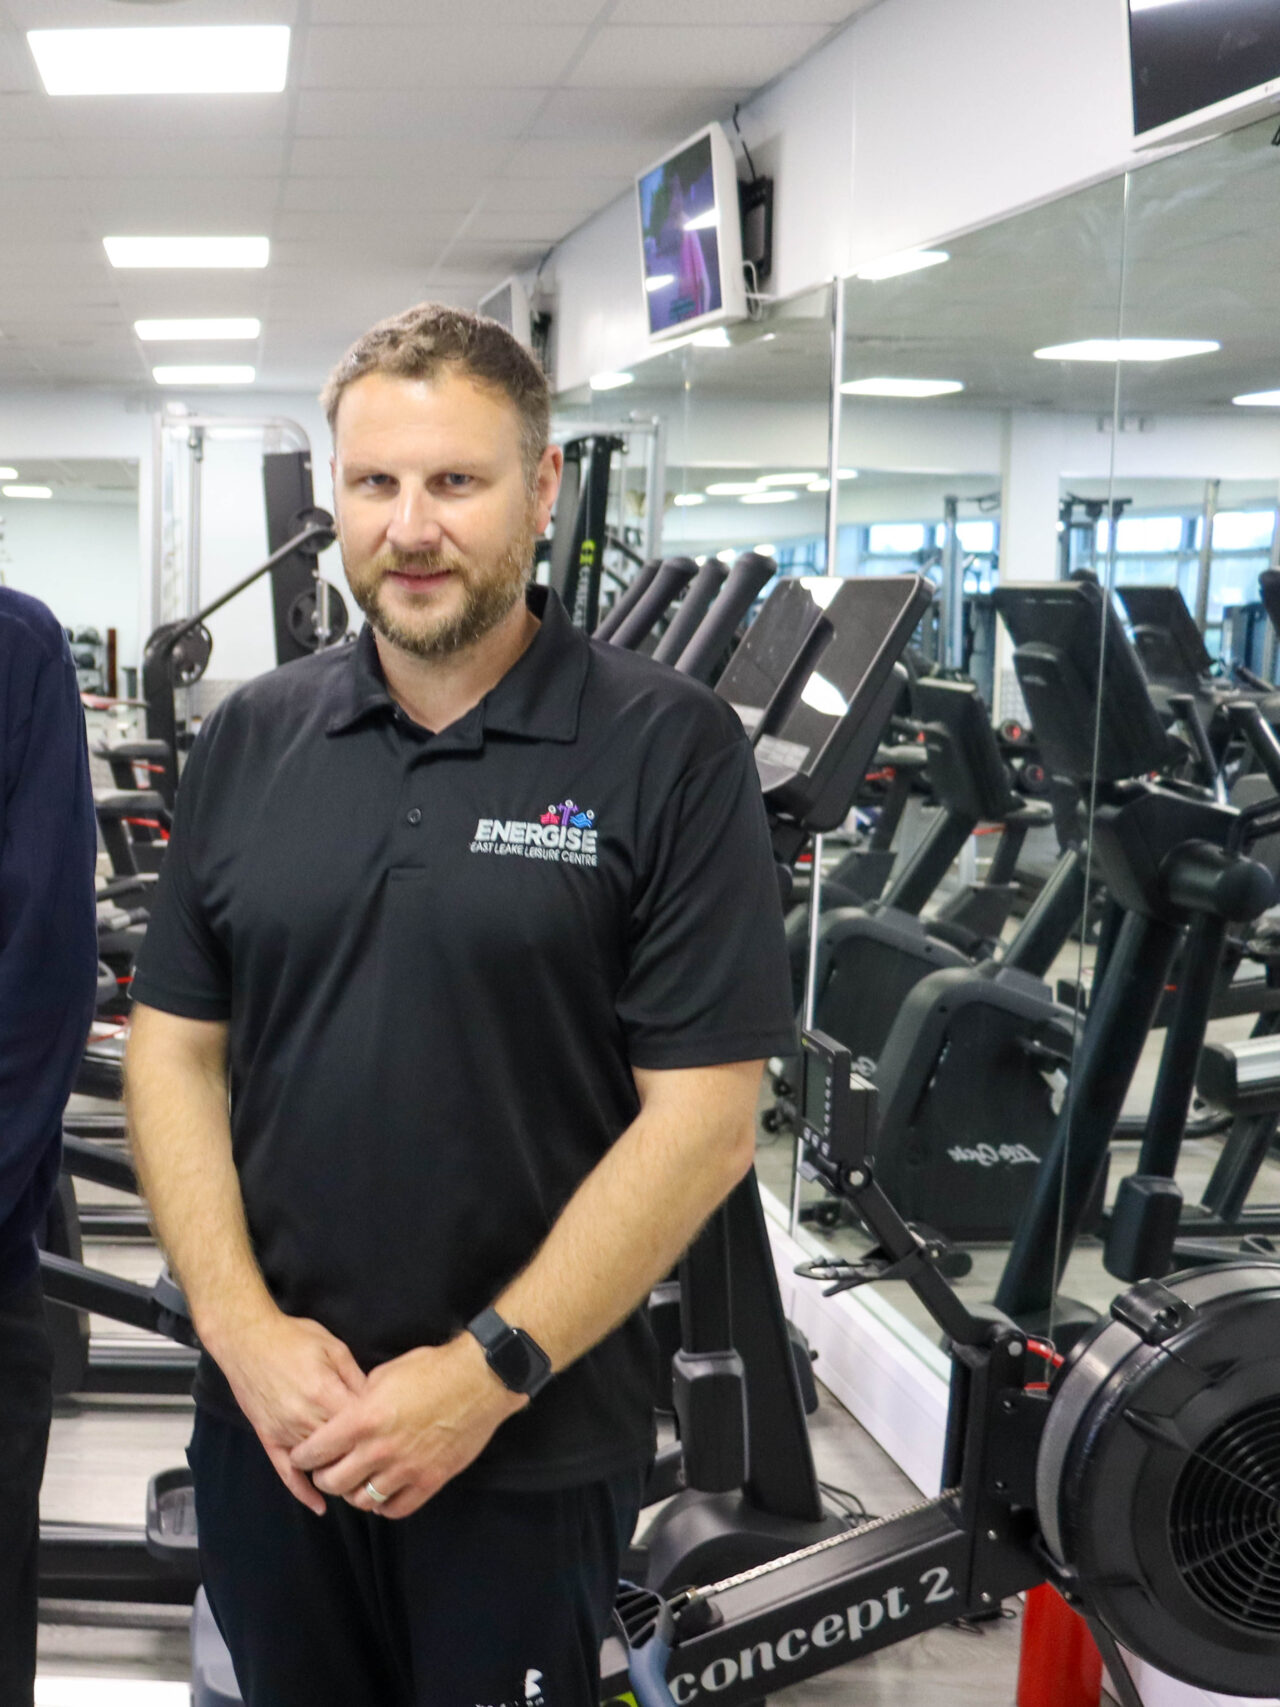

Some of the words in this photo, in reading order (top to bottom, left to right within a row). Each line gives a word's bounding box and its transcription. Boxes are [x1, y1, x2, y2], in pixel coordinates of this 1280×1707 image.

[470, 841, 494, 854] EAST
[494, 842, 524, 857] LEAKE
[524, 845, 561, 862] LEISURE
[561, 850, 598, 867] CENTRE
[474, 818, 598, 854] ENERGISE
[668, 1585, 911, 1706] concept
[919, 1566, 955, 1605] 2
